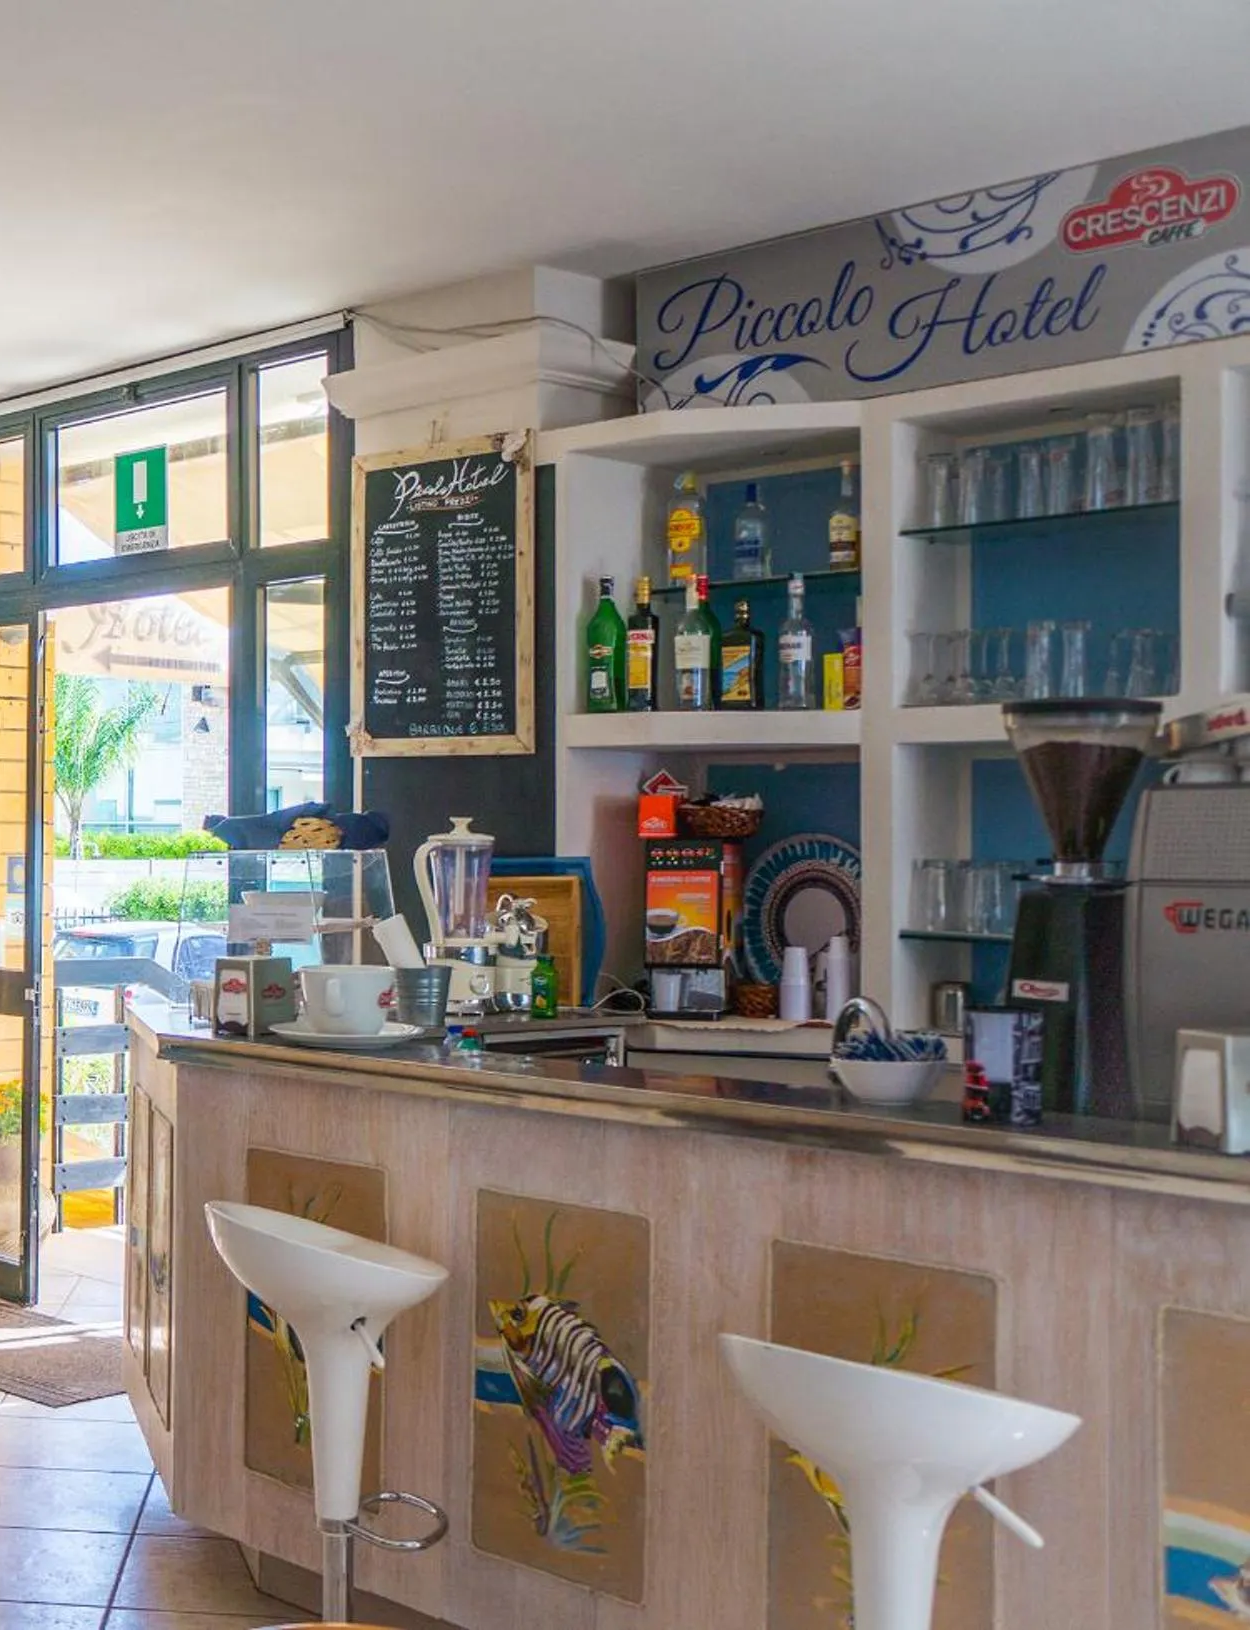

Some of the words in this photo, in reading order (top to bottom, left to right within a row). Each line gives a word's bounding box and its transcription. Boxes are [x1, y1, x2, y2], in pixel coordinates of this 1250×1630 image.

[1067, 185, 1227, 243] CRESCENZI
[653, 261, 875, 371] Piccolo
[845, 263, 1108, 382] Hotel
[1178, 906, 1250, 932] WEGA
